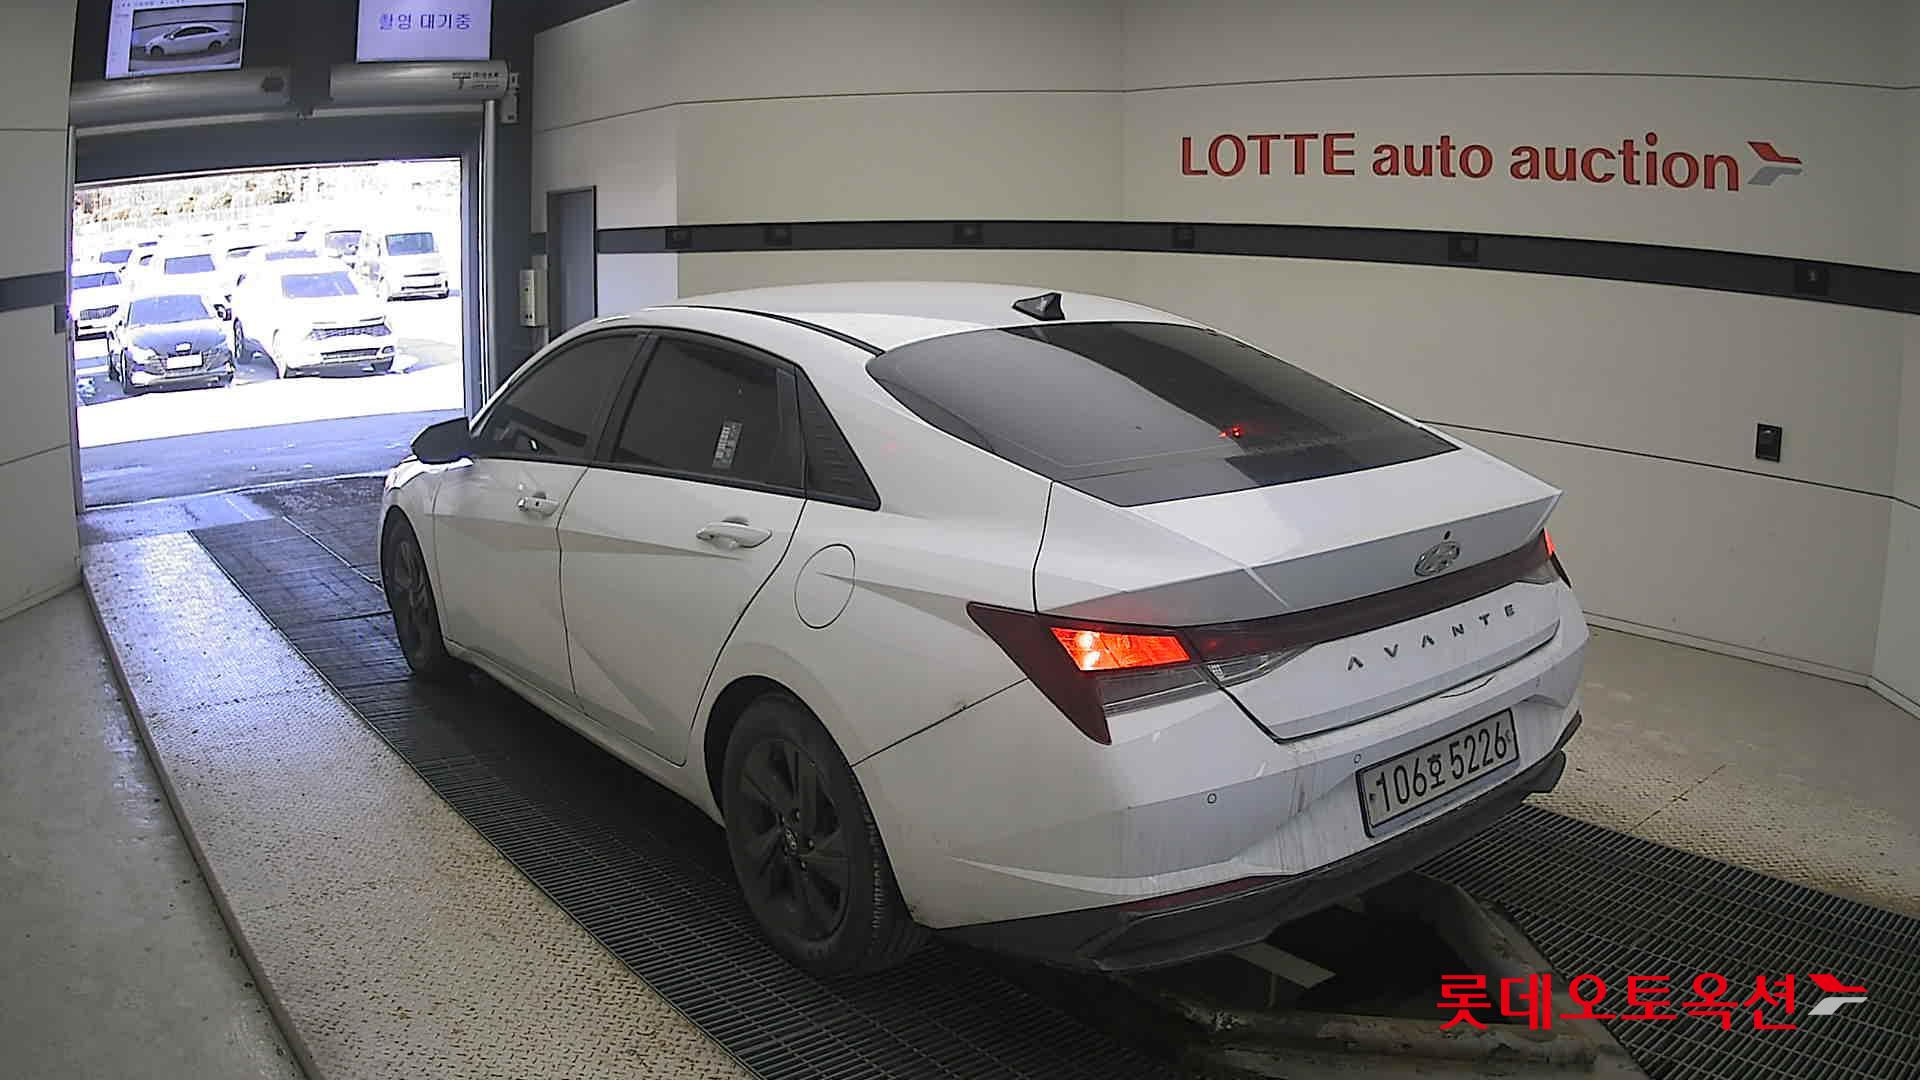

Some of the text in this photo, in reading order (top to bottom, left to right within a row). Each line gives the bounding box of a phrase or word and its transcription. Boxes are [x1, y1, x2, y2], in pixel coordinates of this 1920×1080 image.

[420, 13, 472, 31] 대기중
[1181, 132, 1740, 191] LOTTE auto auction
[1347, 604, 1516, 671] AVANTE
